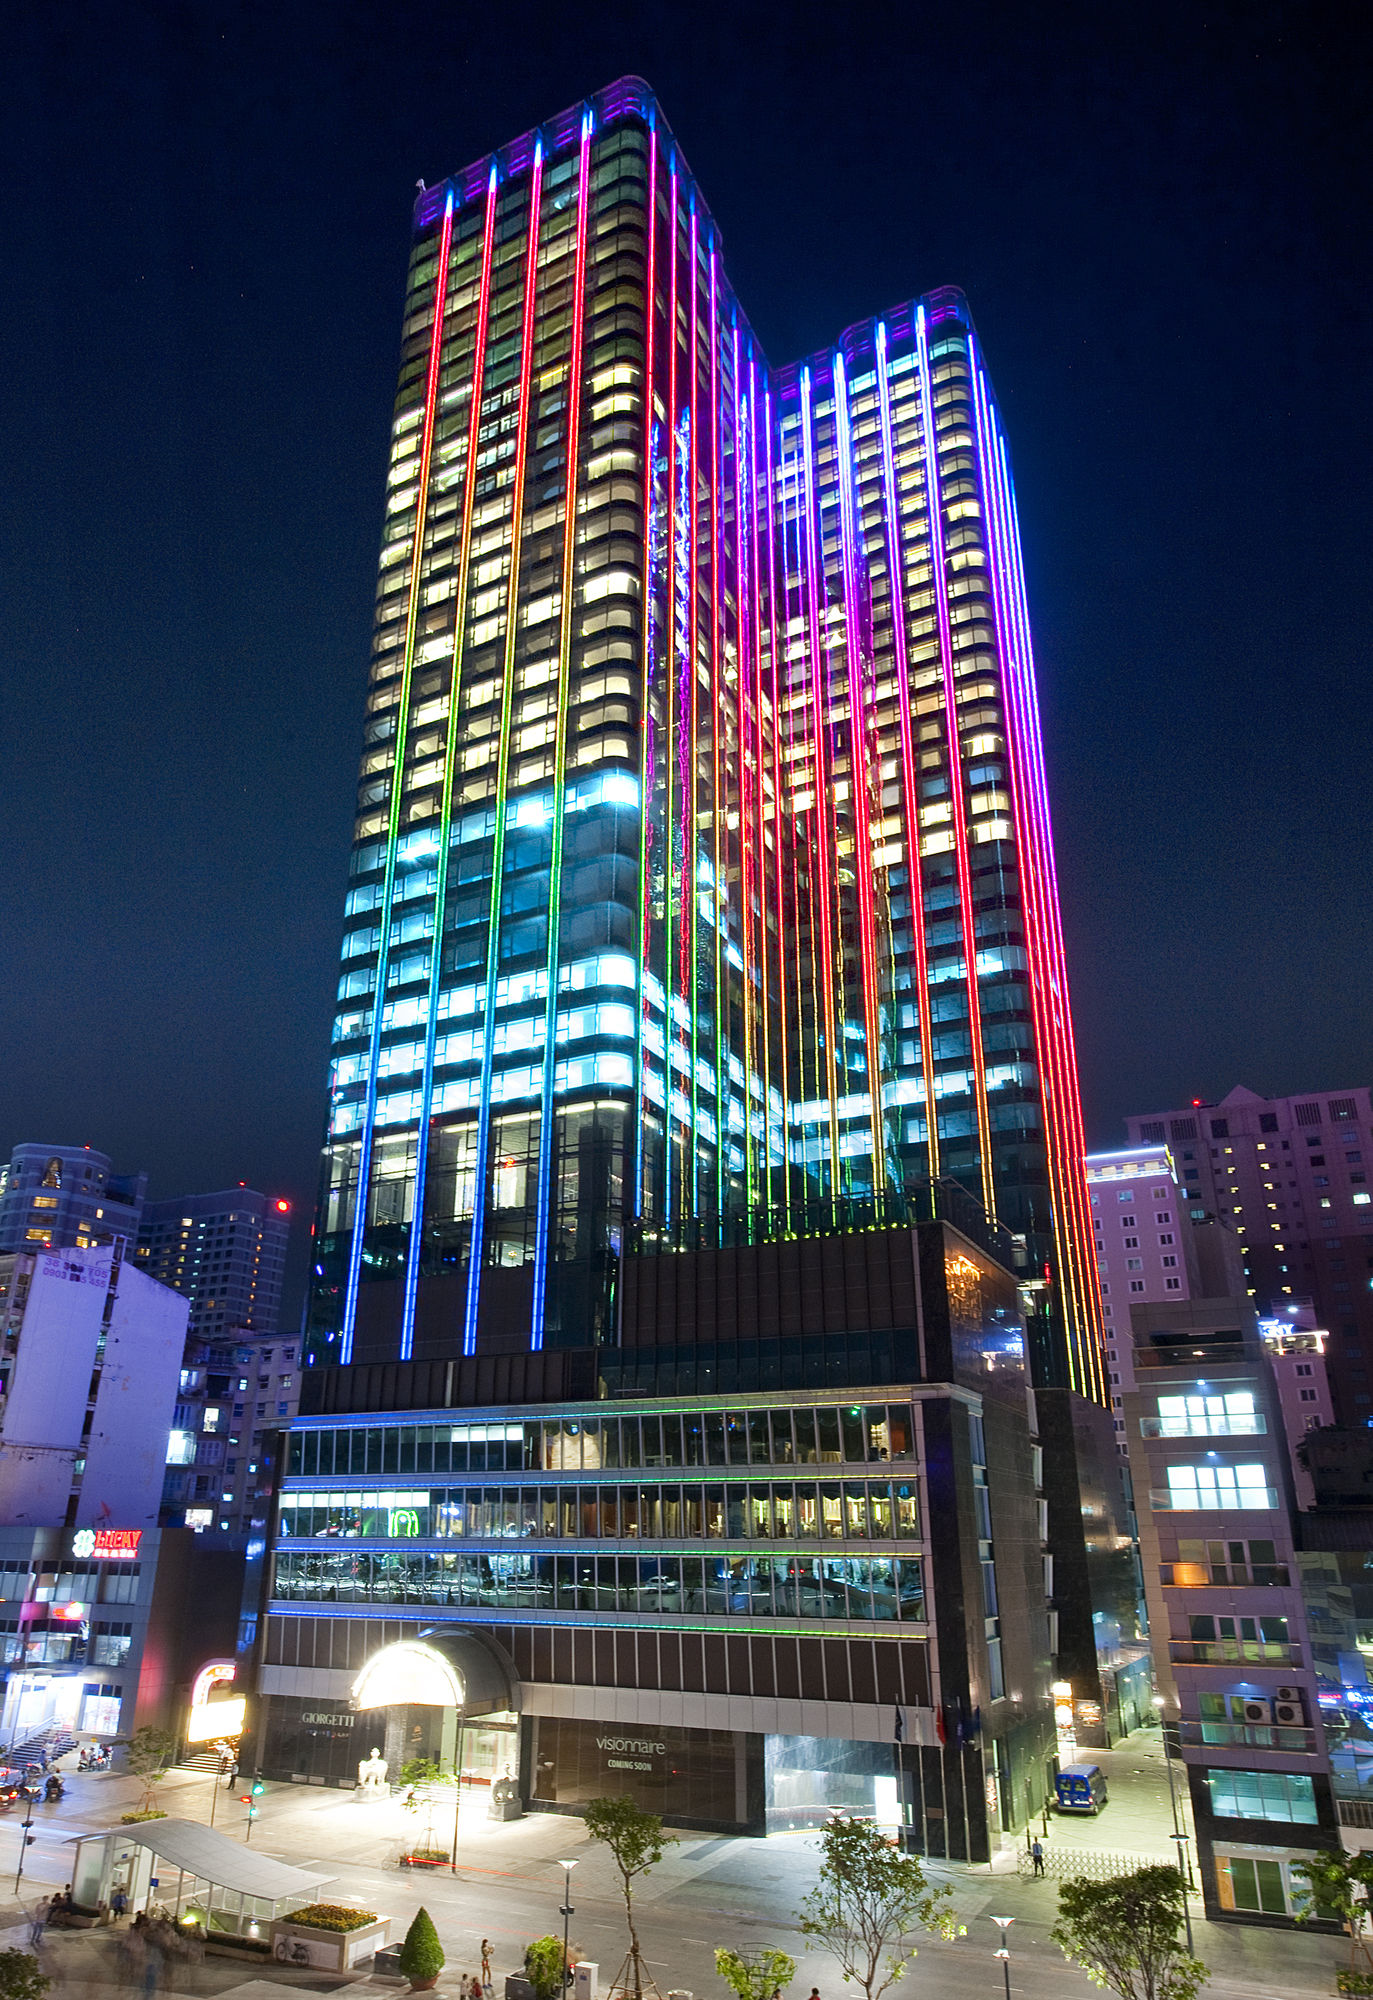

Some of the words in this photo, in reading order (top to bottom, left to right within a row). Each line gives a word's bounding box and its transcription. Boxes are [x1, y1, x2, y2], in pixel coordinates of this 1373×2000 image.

[94, 1529, 143, 1548] LUCKY
[302, 1712, 355, 1727] GIORGETTI
[596, 1736, 666, 1755] visionnaire
[608, 1759, 634, 1770] COMING
[634, 1761, 652, 1771] SOON
